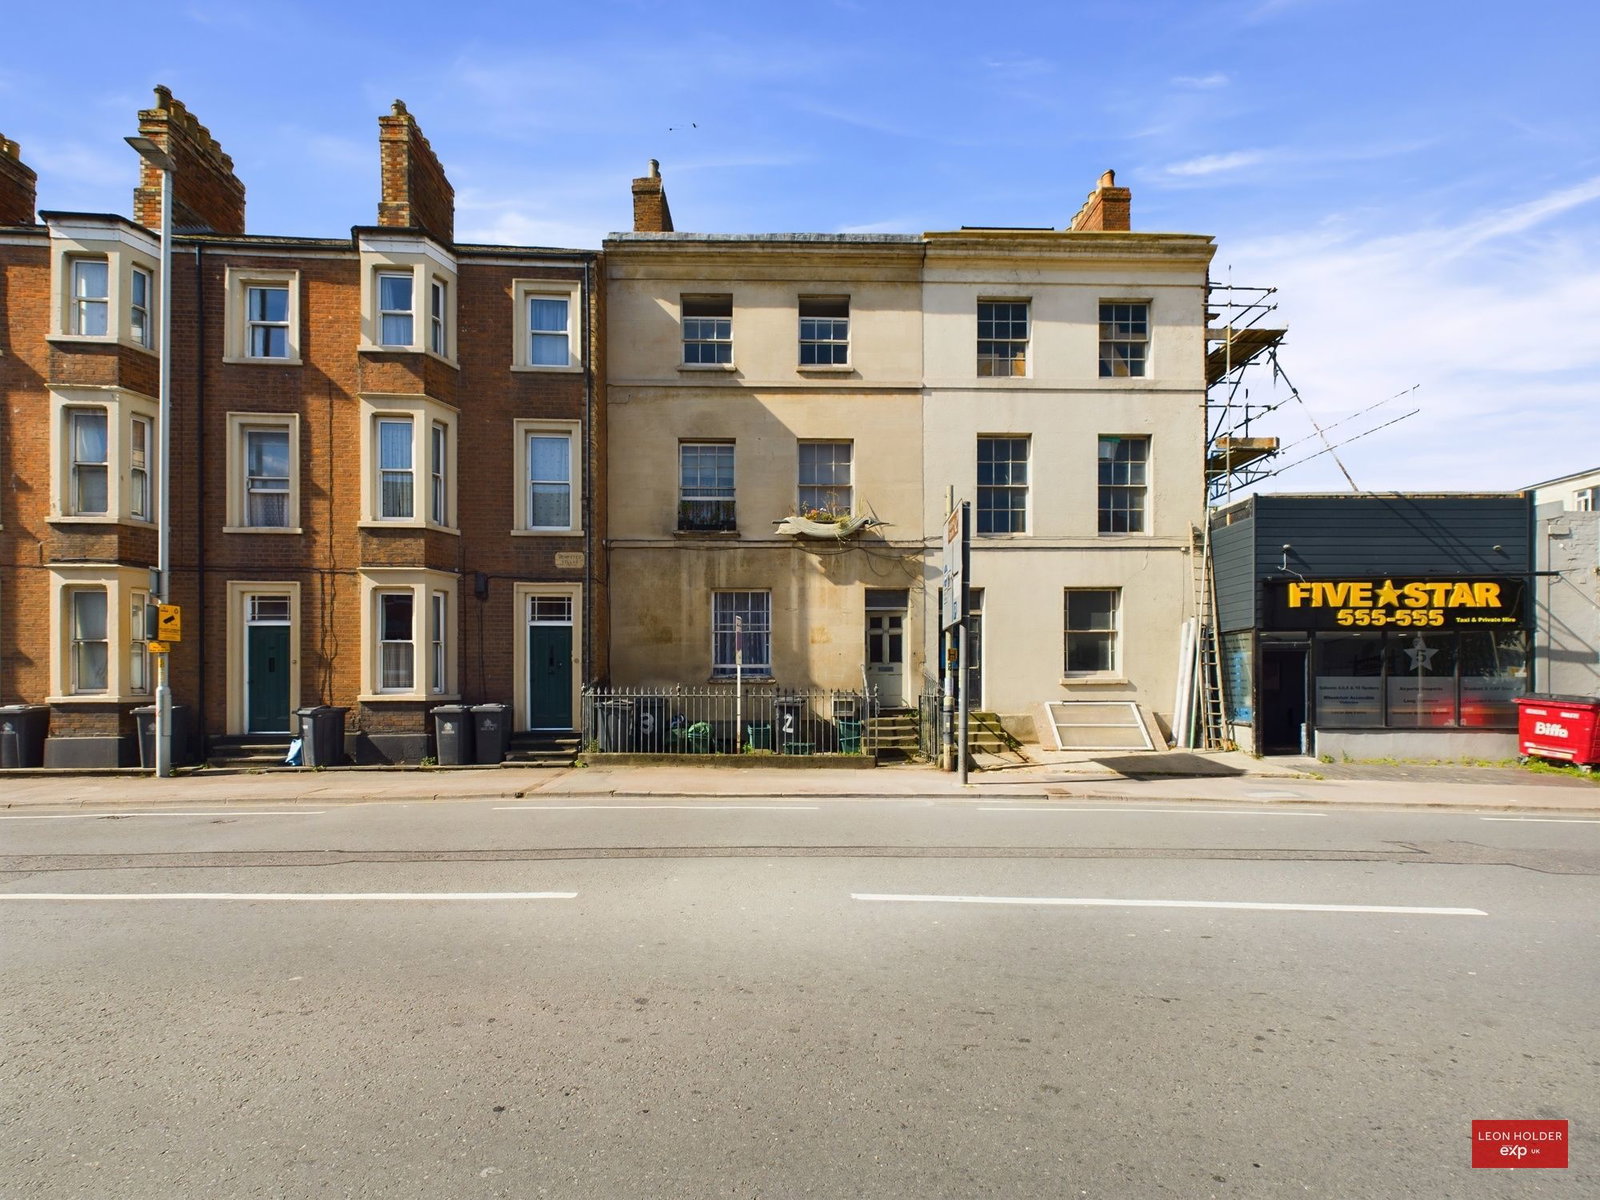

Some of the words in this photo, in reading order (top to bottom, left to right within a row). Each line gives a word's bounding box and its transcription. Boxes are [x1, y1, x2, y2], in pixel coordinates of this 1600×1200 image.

[1289, 582, 1373, 608] FIVE
[1403, 582, 1502, 608] STAR
[1337, 609, 1444, 627] 555-555
[641, 712, 654, 735] 3
[782, 713, 794, 733] 2
[1534, 721, 1569, 739] Biffa
